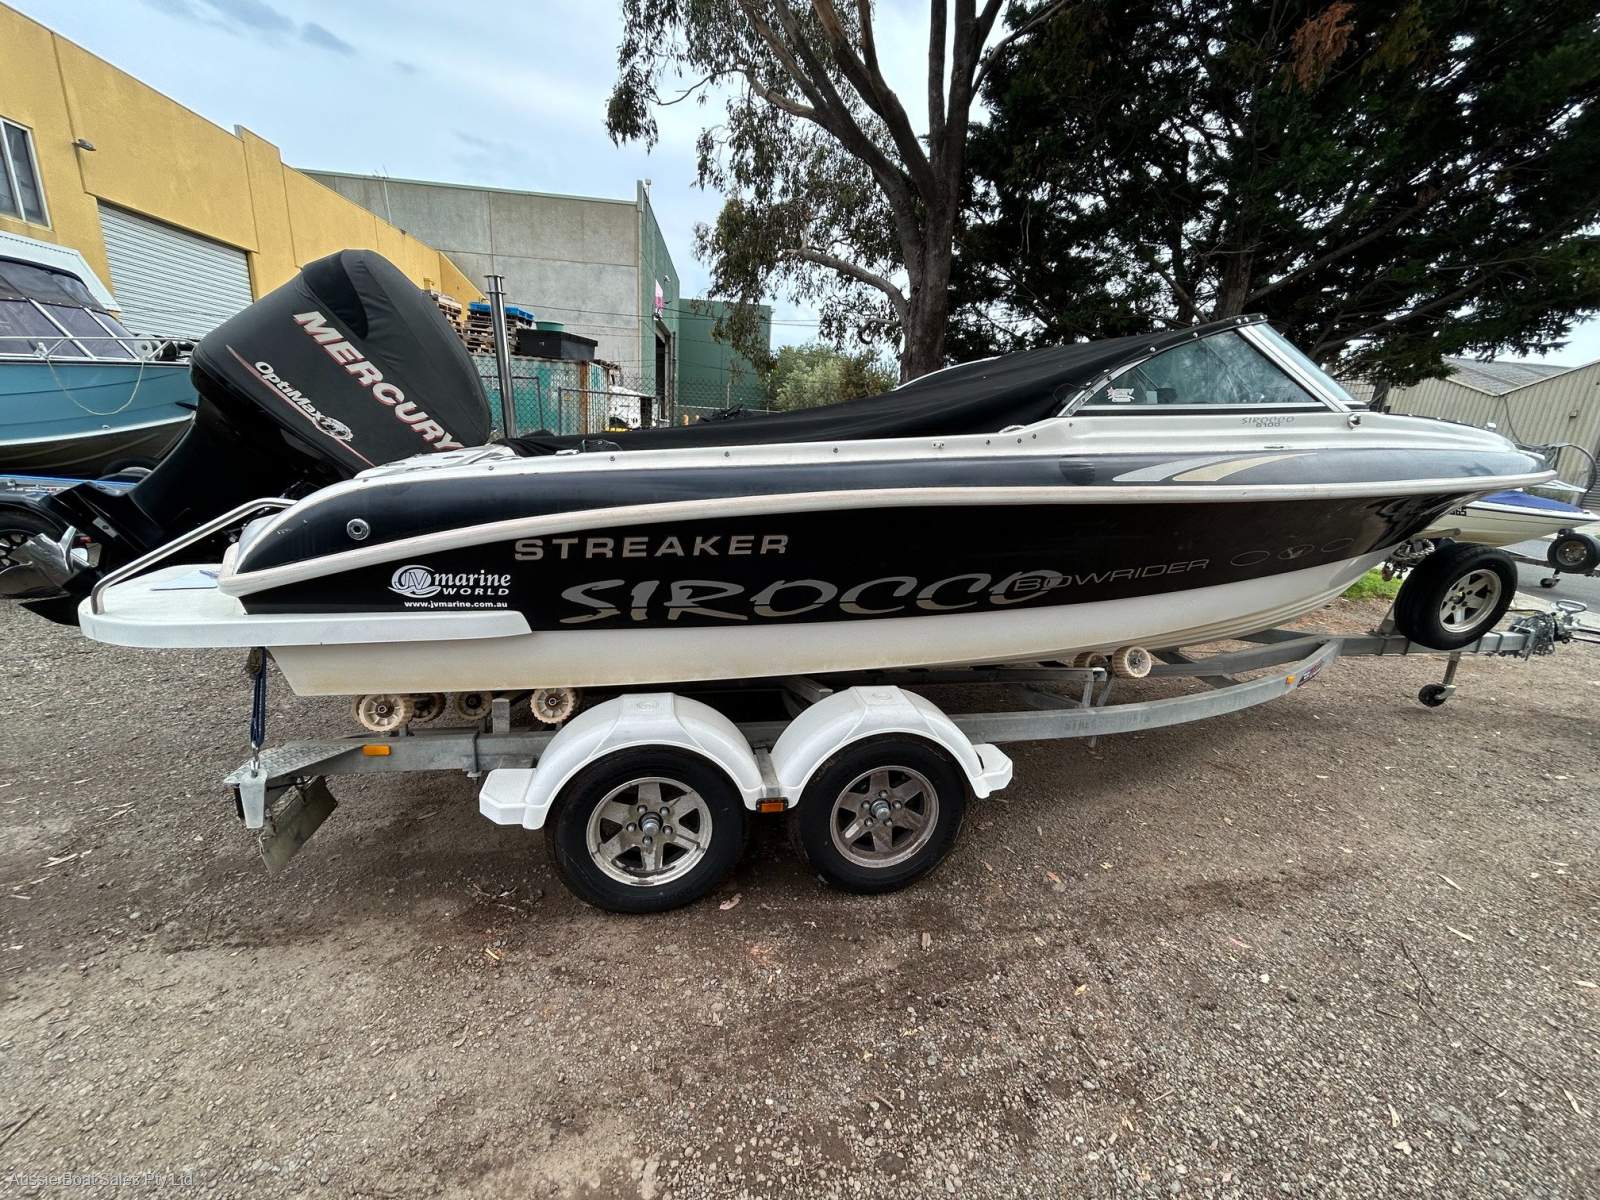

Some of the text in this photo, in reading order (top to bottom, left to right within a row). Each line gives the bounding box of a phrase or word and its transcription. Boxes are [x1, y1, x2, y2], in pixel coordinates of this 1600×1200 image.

[254, 361, 325, 421] OptiMax
[293, 311, 465, 450] MERCURY
[514, 535, 789, 561] STREAKER
[433, 569, 511, 586] marine
[560, 569, 1063, 624] SIROCCO
[1014, 558, 1210, 592] BOWRIDER
